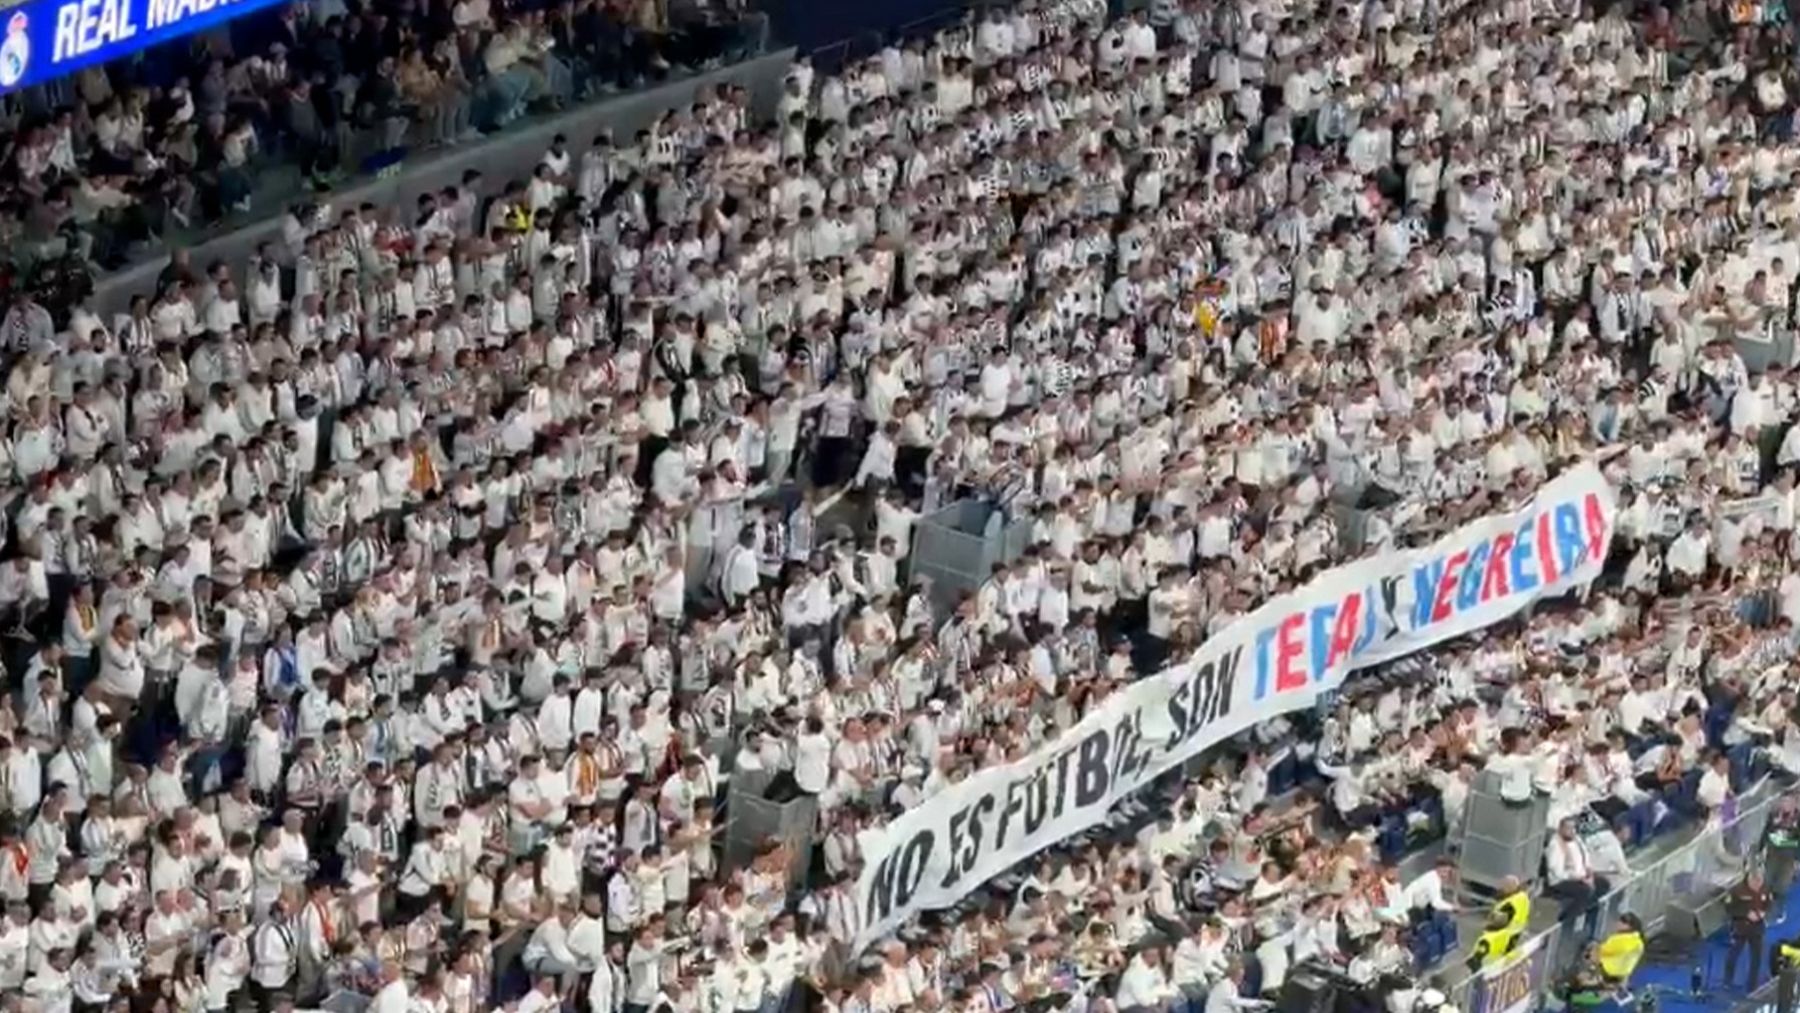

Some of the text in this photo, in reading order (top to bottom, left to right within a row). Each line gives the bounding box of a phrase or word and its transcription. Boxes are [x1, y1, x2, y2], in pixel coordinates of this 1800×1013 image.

[52, 0, 136, 62] REAL
[866, 829, 935, 929] NO
[941, 793, 995, 888] ES
[1166, 645, 1243, 752] SON
[1380, 574, 1406, 641] Y
[1410, 492, 1607, 630] NEGREIRA
